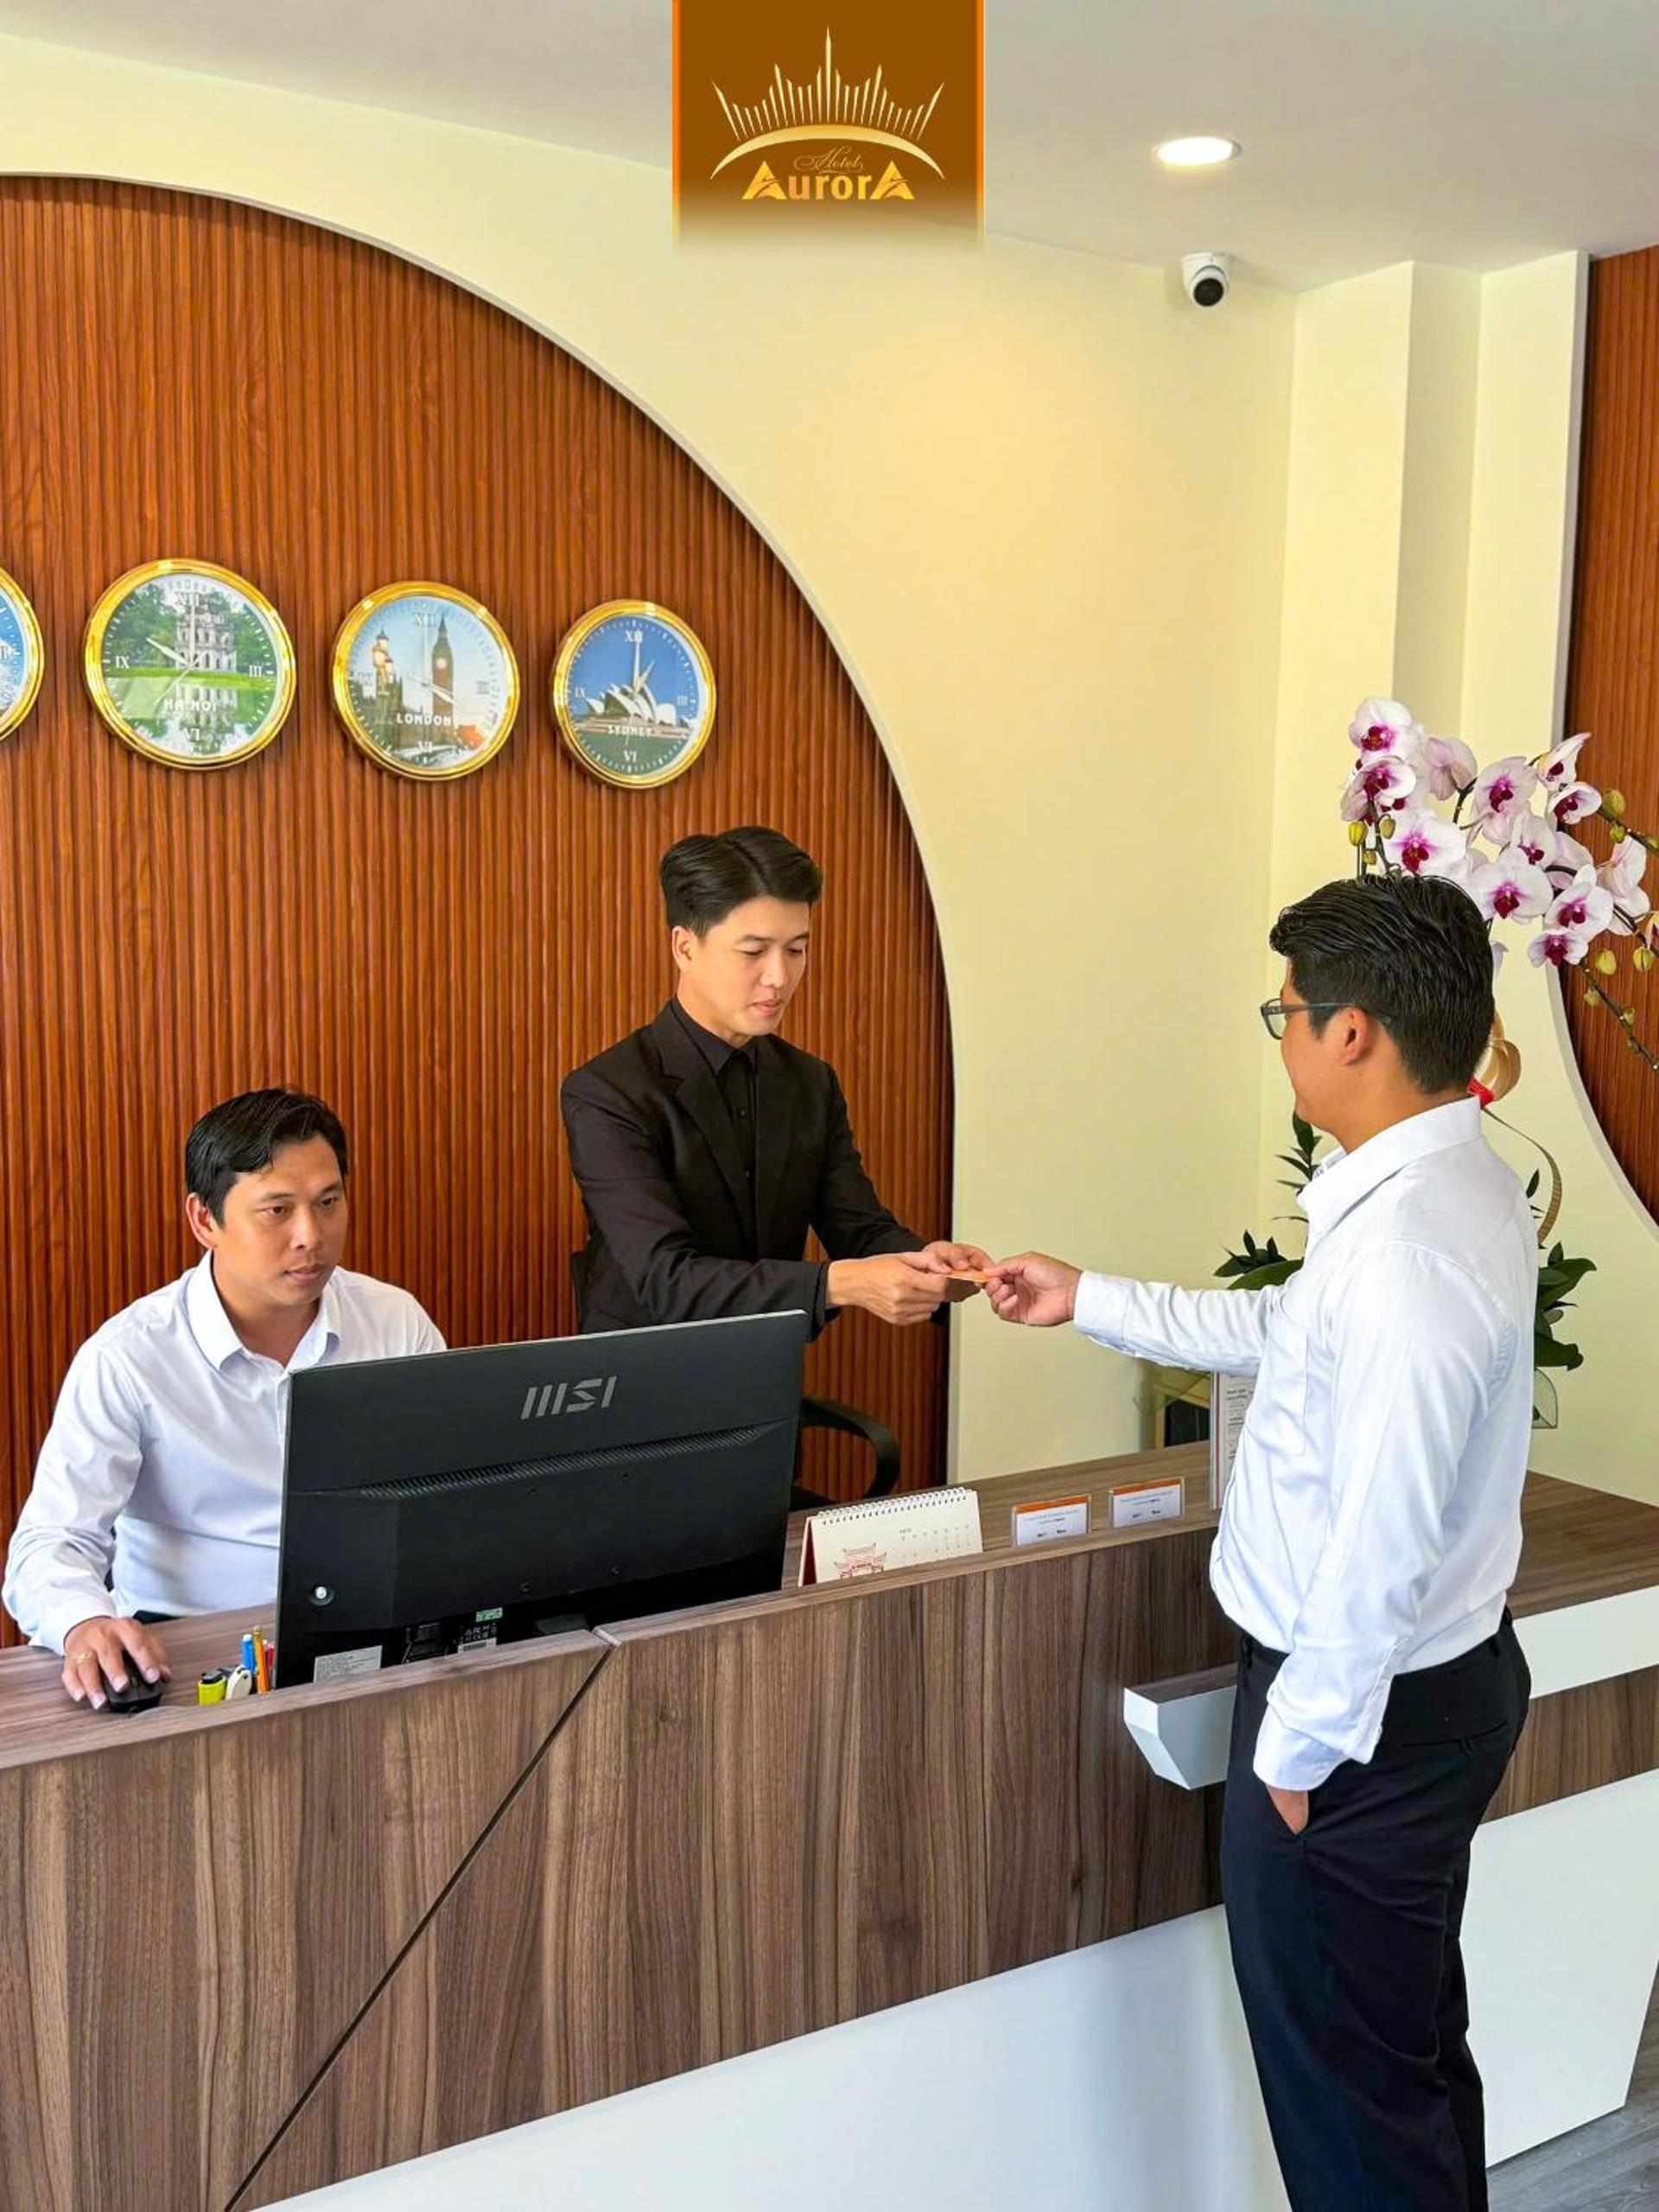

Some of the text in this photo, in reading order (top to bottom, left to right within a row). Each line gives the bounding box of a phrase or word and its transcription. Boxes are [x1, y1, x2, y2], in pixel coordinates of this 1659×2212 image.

[115, 655, 130, 669] IX
[249, 665, 263, 678] III
[677, 696, 689, 707] III
[397, 713, 452, 725] LONDON
[607, 725, 652, 737] SYDNEY
[623, 750, 637, 762] VI
[520, 1376, 617, 1420] MSI
